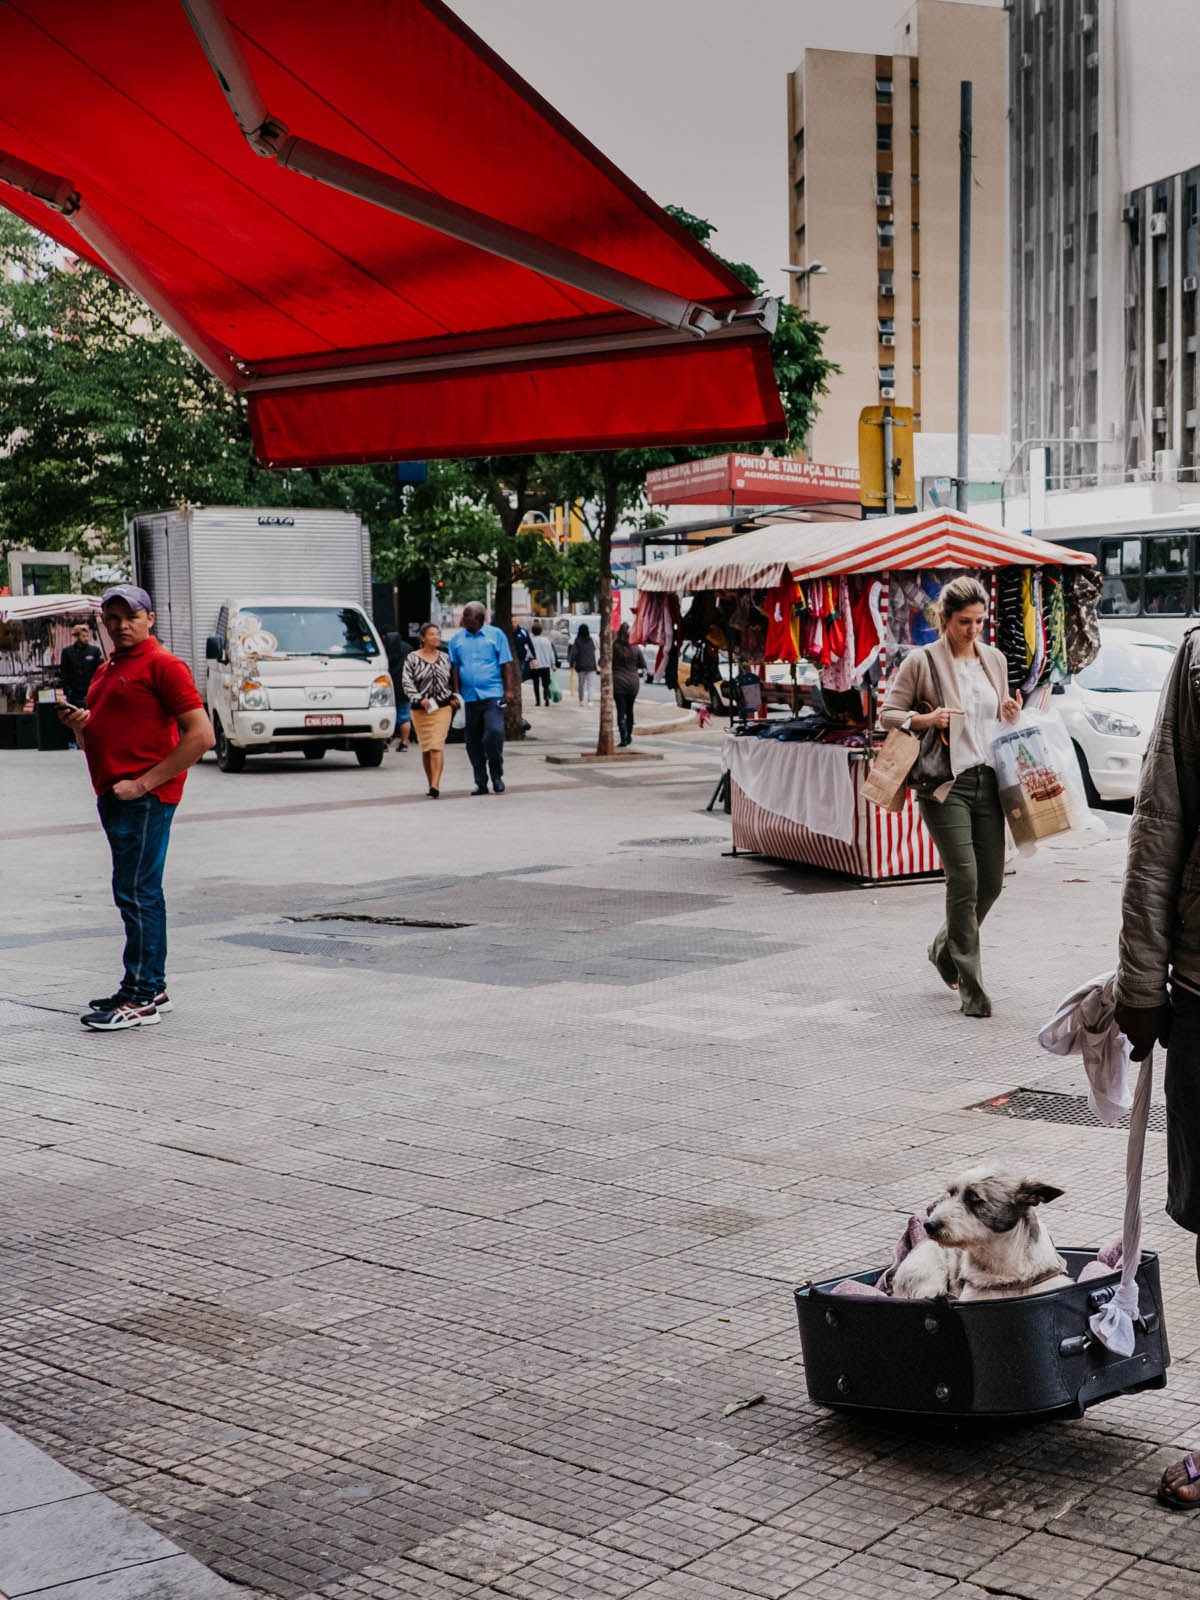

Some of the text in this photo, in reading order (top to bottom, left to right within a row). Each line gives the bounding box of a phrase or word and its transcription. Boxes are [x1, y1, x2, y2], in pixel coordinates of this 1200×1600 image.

[735, 455, 766, 471] PONTO
[768, 459, 780, 471] DE
[781, 459, 801, 473] TAXI
[825, 465, 836, 478] DA
